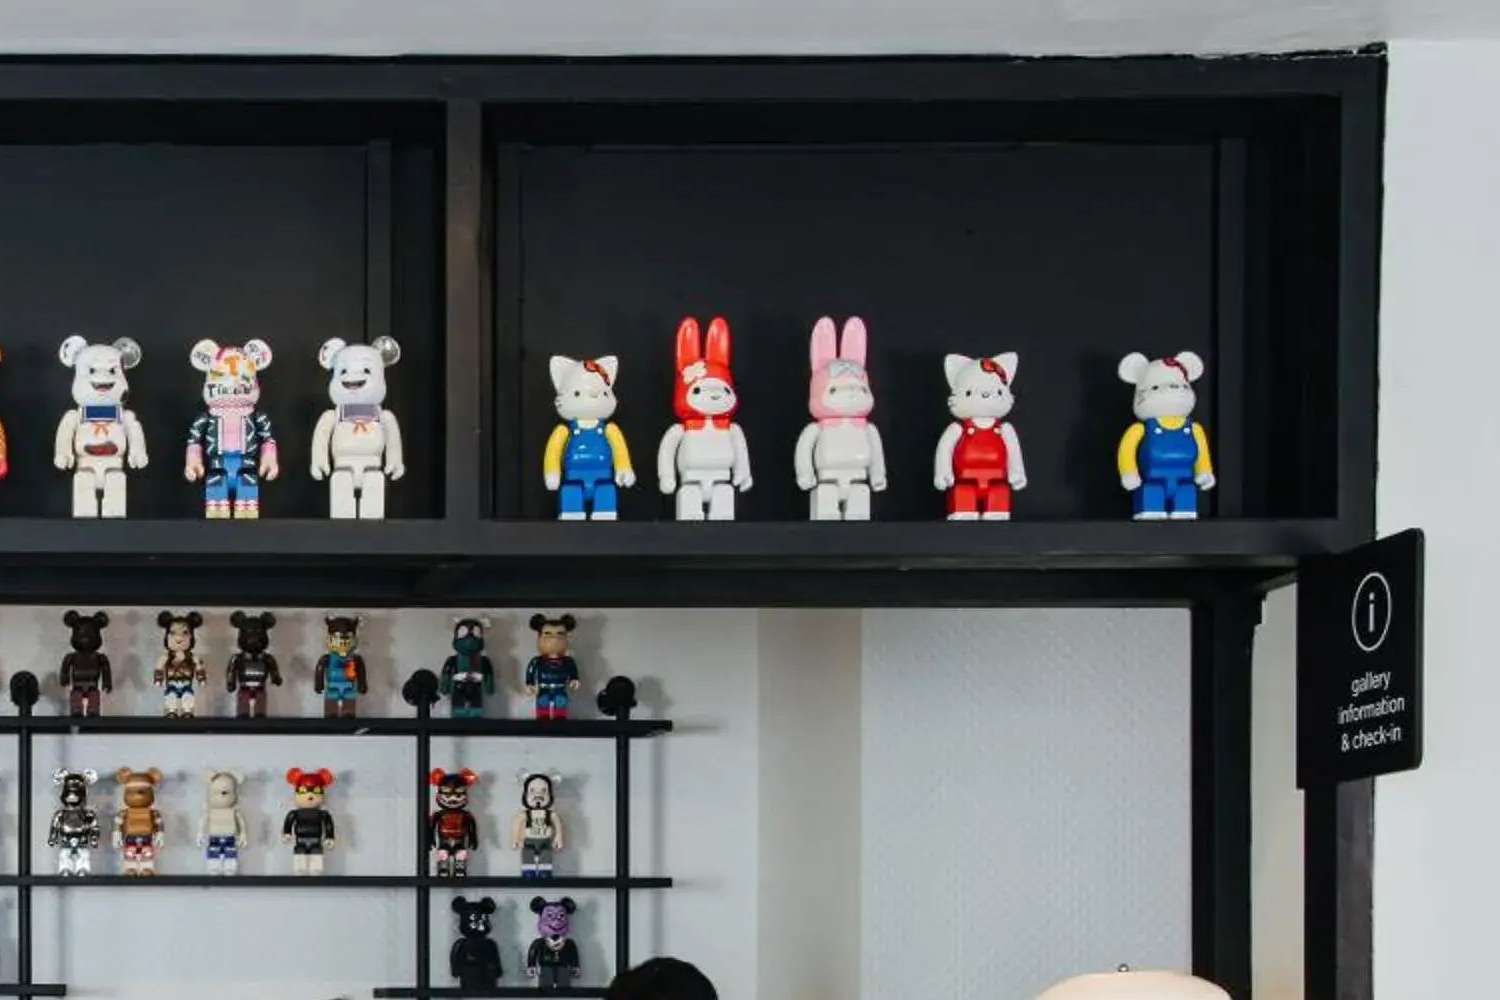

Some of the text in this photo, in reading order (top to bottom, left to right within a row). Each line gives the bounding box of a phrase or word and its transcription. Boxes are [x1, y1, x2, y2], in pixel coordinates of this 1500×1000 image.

[1351, 671, 1391, 697] gallery
[1338, 695, 1405, 725] information
[1341, 723, 1401, 752] & check-in
